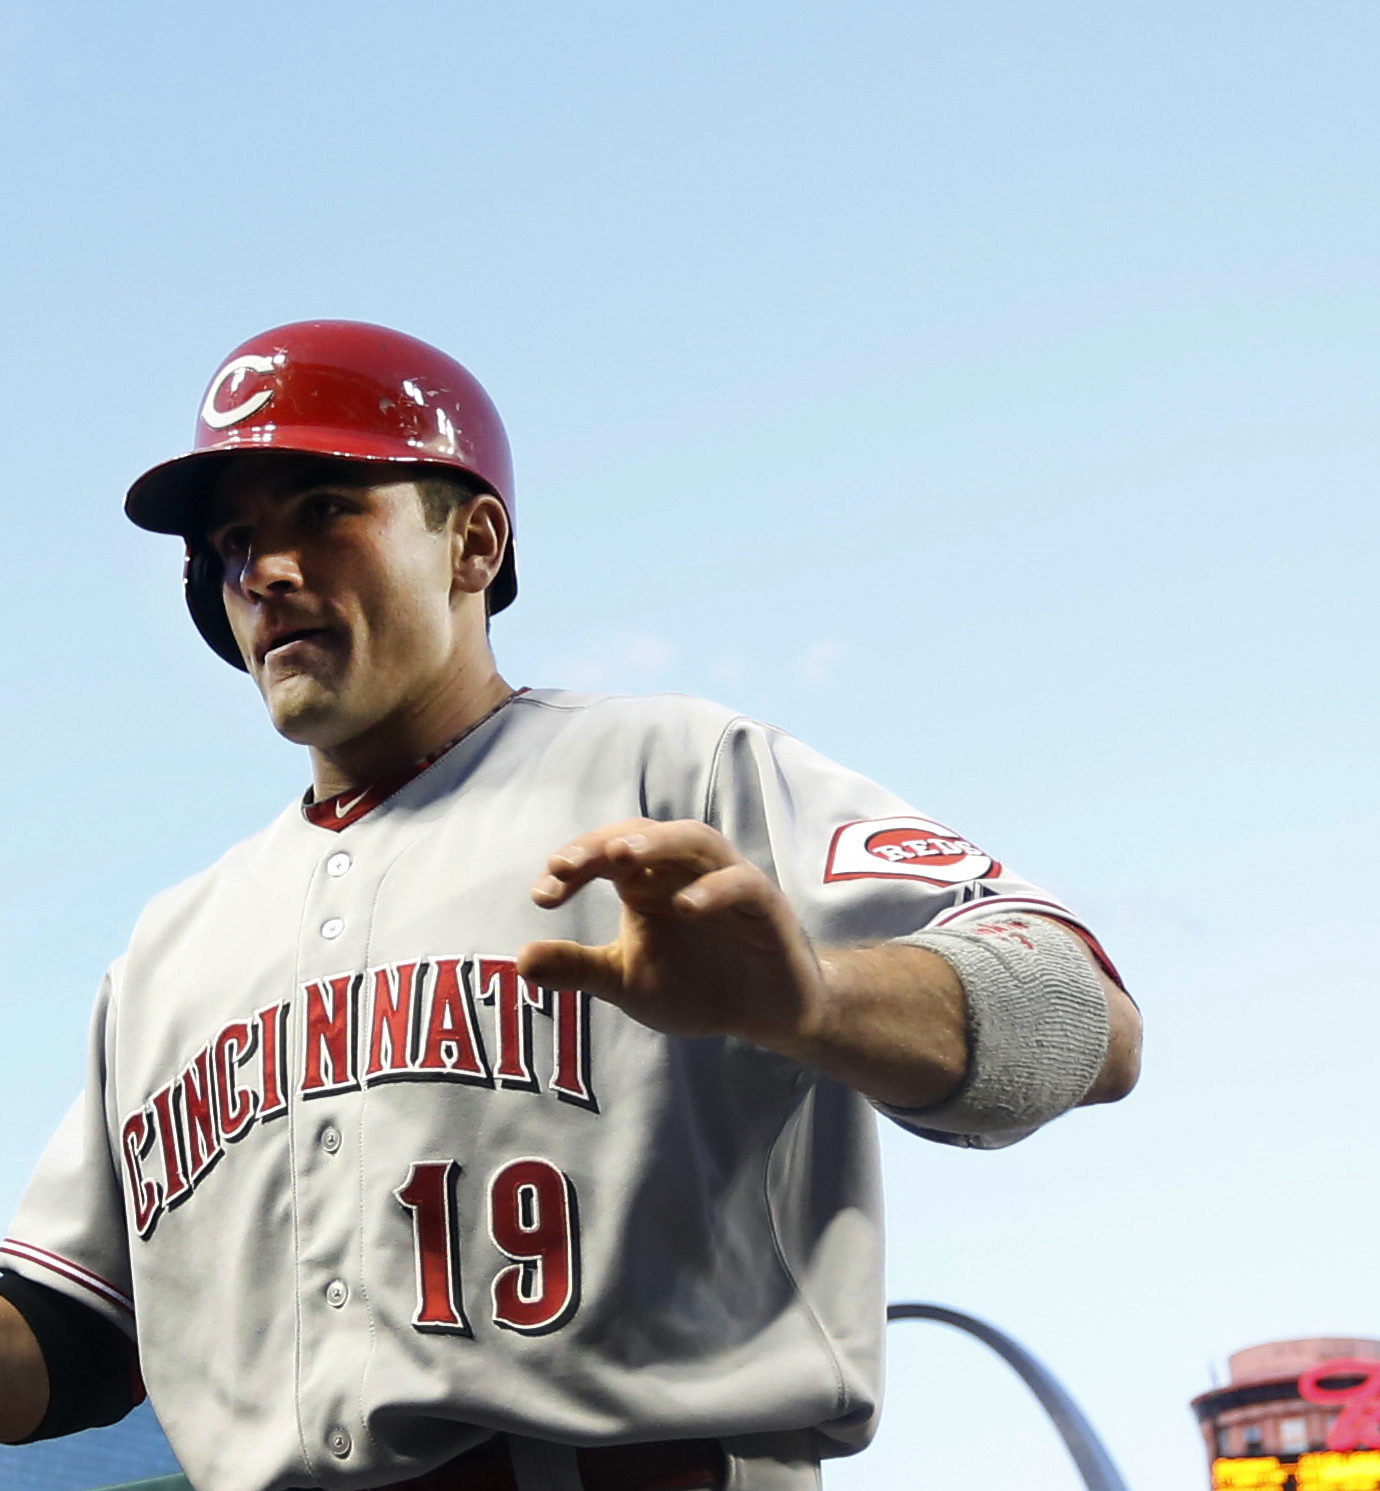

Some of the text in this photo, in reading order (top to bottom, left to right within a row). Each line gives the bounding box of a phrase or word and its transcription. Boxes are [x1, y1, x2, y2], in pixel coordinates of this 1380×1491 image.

[872, 837, 984, 863] REDS
[122, 952, 600, 1241] CINCINNATI
[393, 1156, 582, 1338] 19
